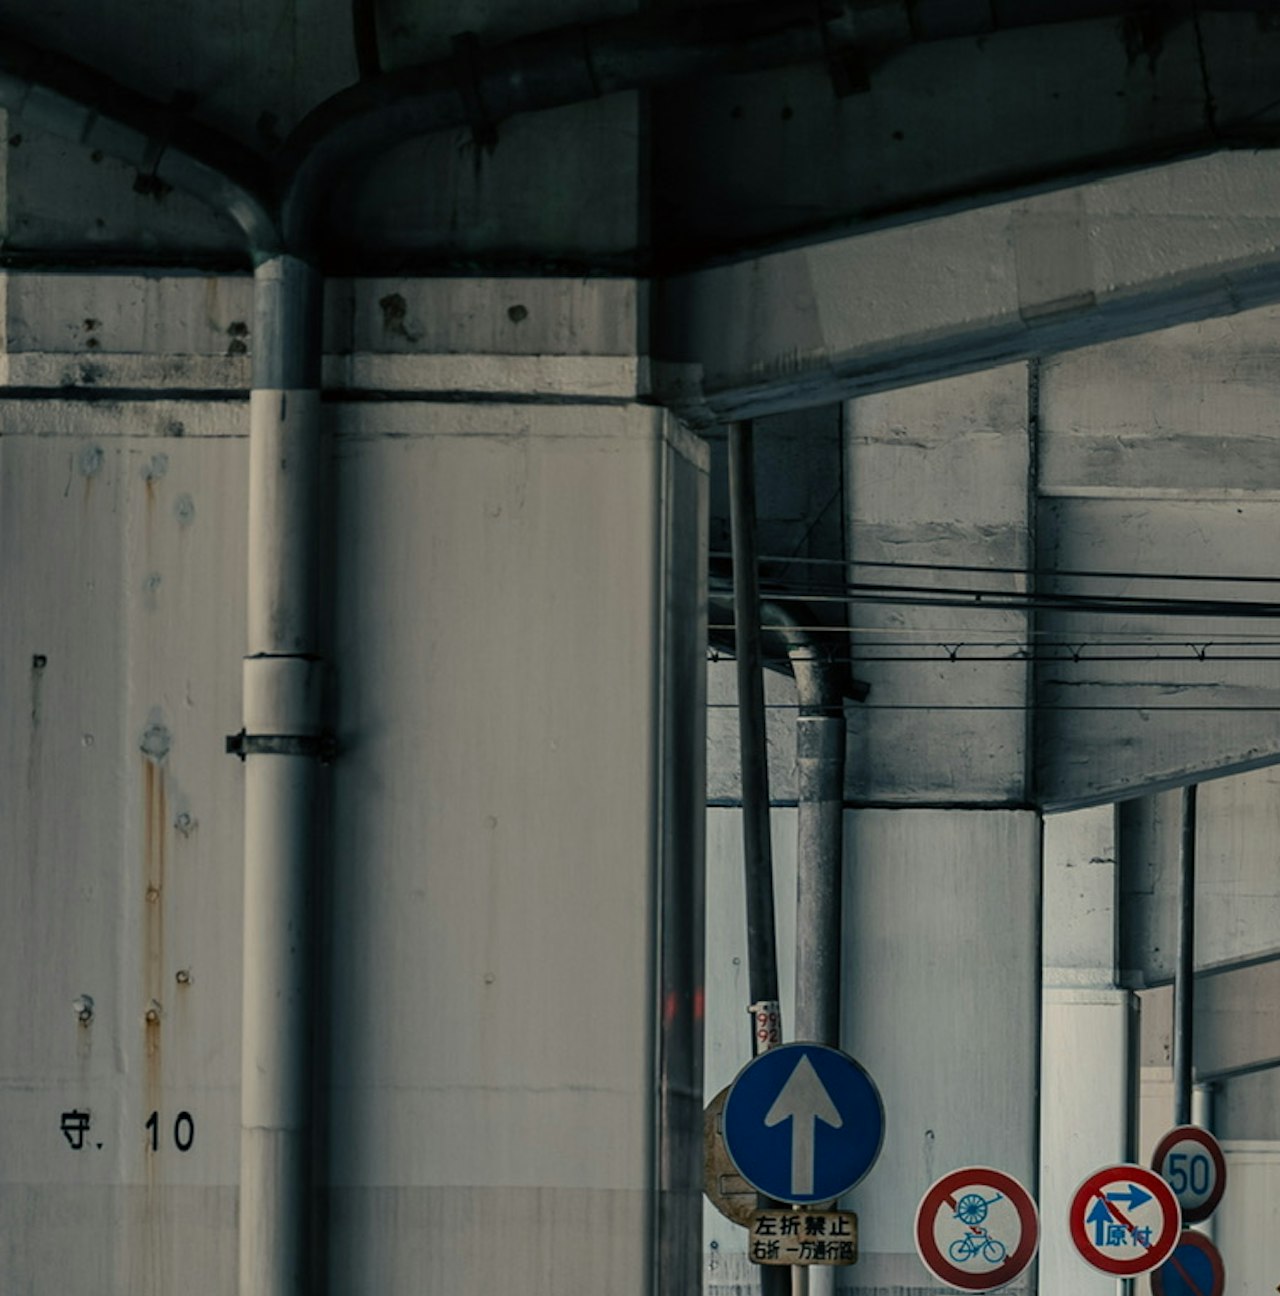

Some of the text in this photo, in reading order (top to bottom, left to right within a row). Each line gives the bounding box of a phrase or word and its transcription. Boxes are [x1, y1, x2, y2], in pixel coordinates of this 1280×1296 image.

[146, 1111, 194, 1151] 10
[1168, 1153, 1209, 1195] 50
[755, 1216, 850, 1235] 左折禁止
[1106, 1225, 1153, 1247] 原付
[753, 1240, 779, 1260] 右折
